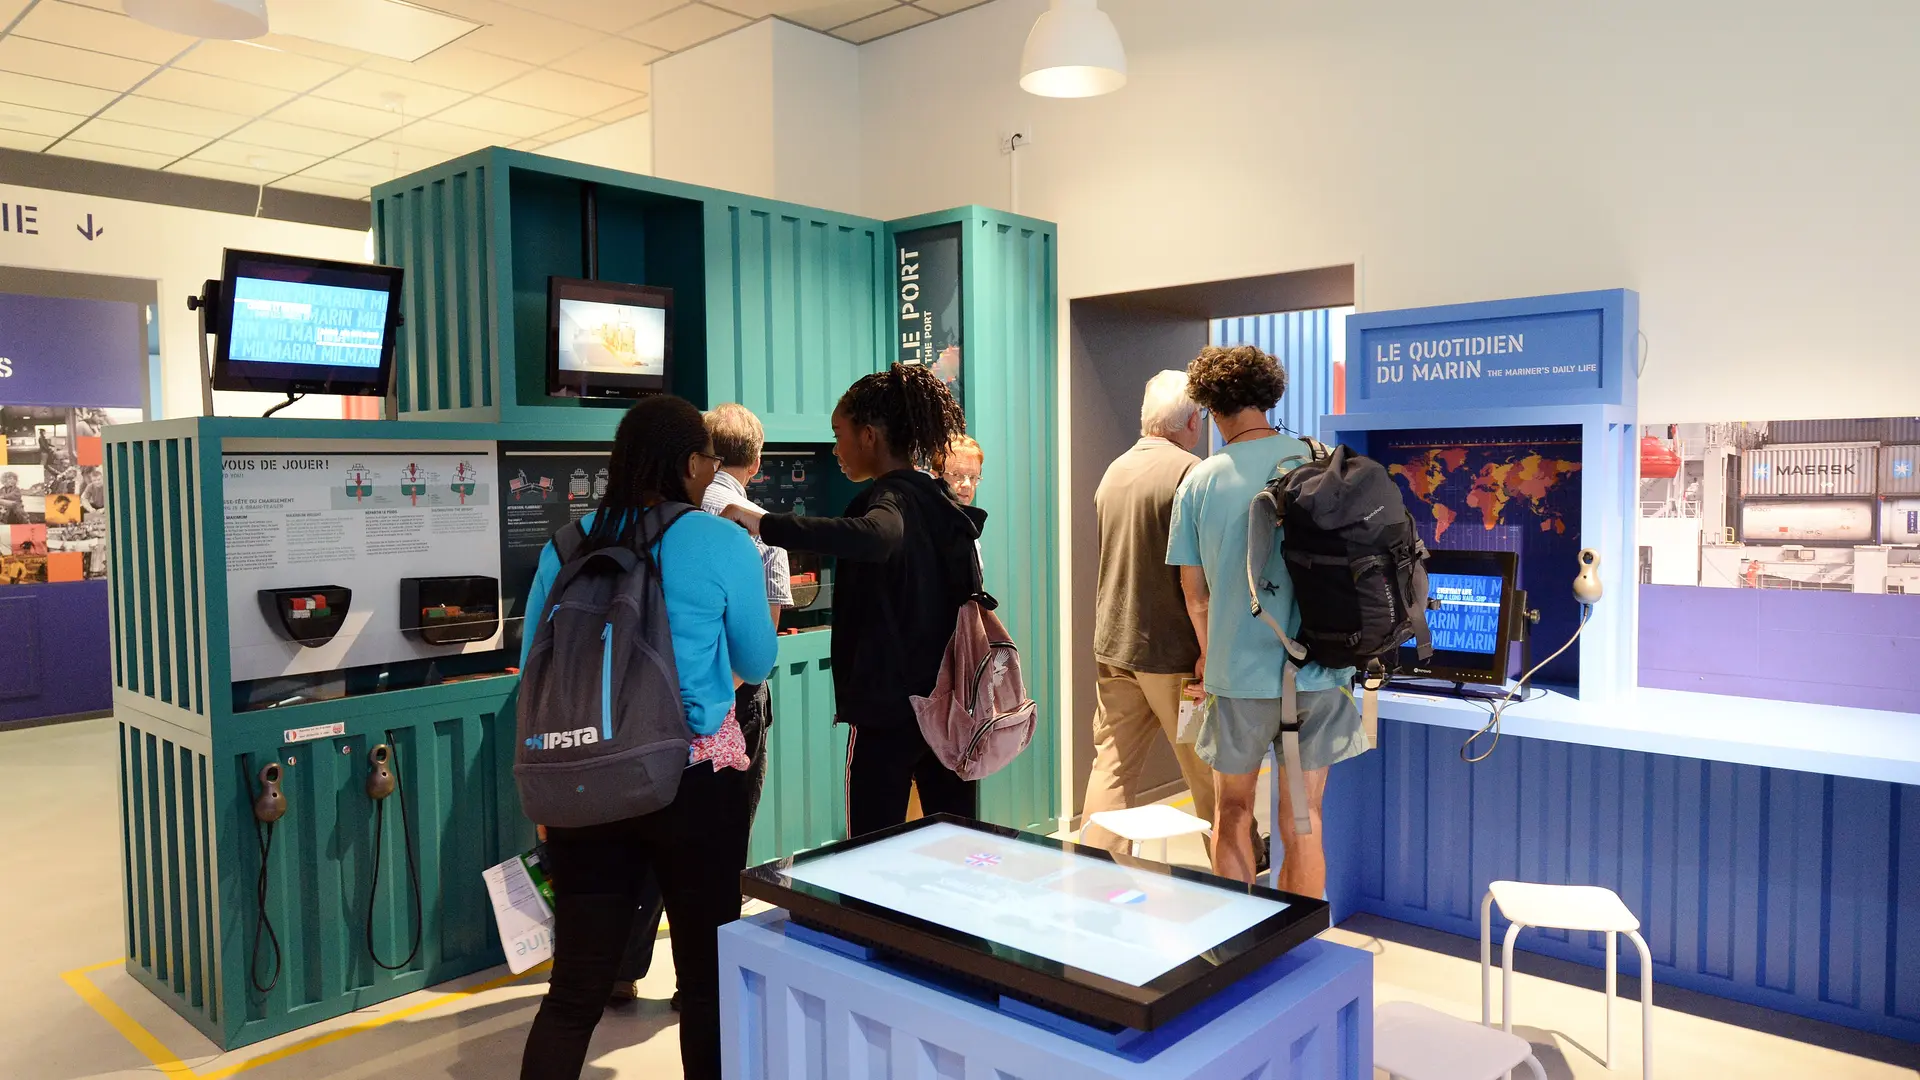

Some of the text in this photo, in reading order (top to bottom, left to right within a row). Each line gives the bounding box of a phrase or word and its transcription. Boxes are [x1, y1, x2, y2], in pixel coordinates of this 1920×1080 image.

[900, 248, 920, 365] LE PORT
[924, 310, 932, 363] THE PORT
[243, 341, 317, 362] MILMARIN
[1377, 334, 1524, 362] LE QUOTIDIEN
[1377, 360, 1481, 384] DU MARIN
[1487, 363, 1597, 378] THE MARINER'S DAILY LIFE
[260, 459, 277, 470] DE
[283, 459, 329, 470] JOUER!
[1776, 463, 1855, 476] MAERSK
